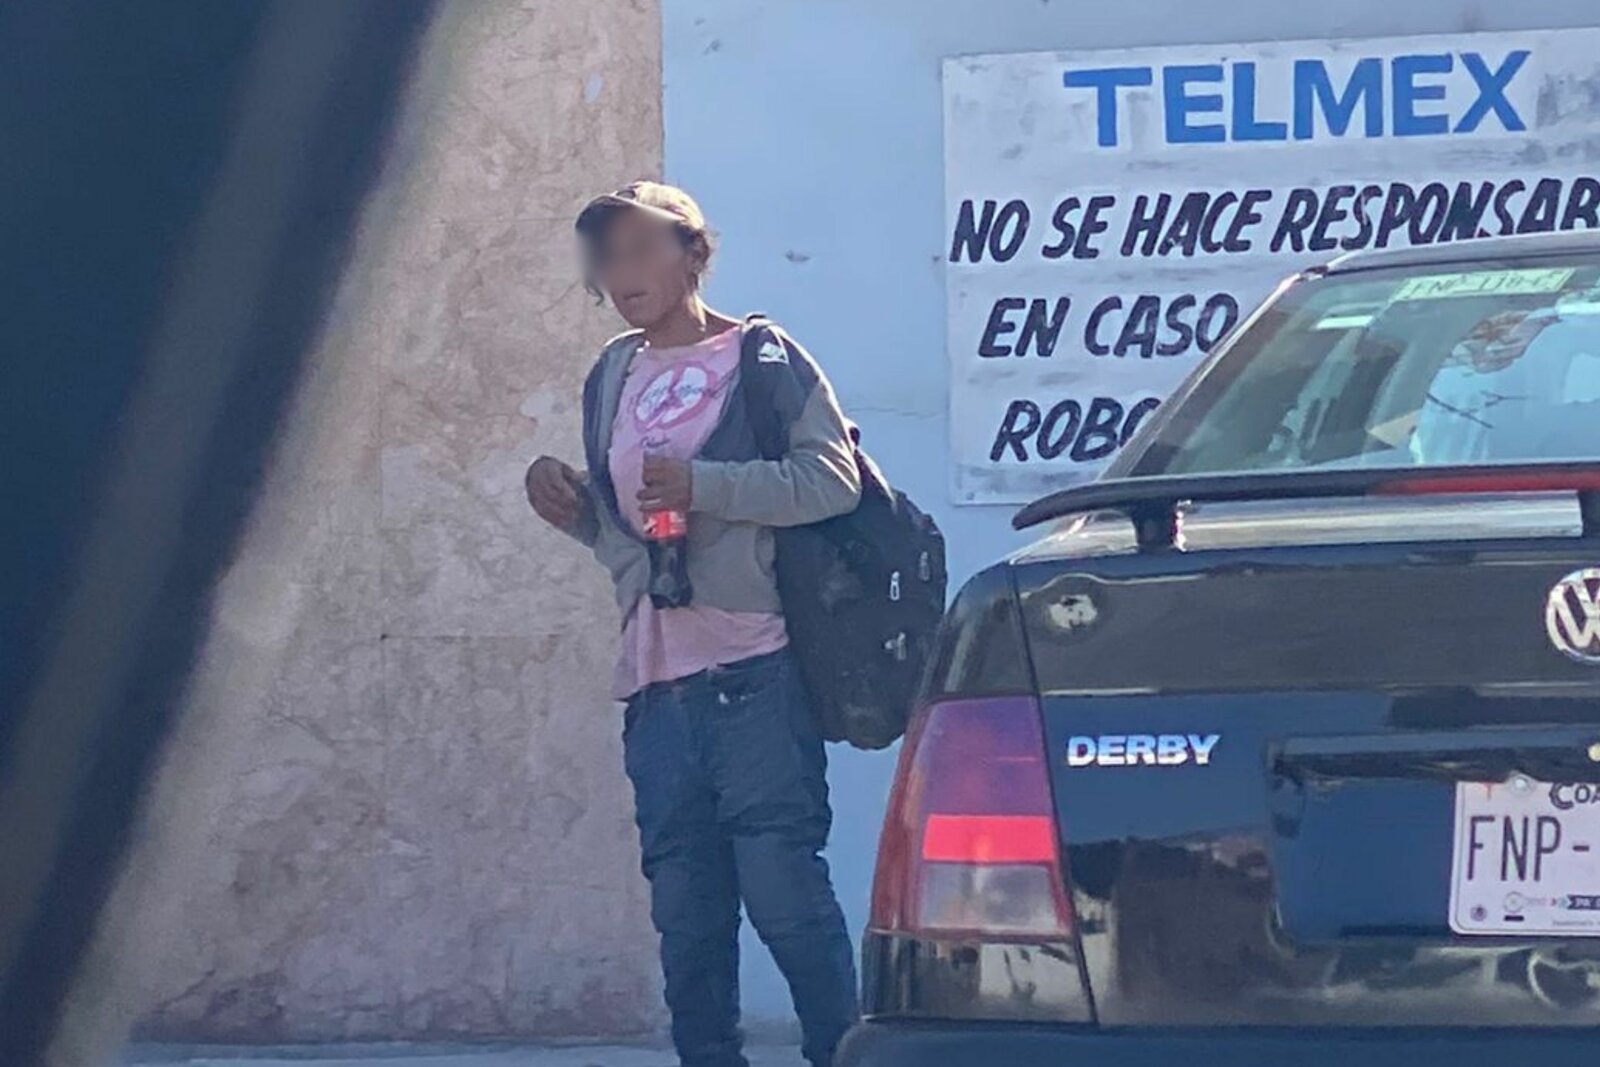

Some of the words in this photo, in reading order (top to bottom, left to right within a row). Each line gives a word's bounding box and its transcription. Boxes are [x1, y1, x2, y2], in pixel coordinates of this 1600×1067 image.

[1063, 50, 1531, 147] TELMEX
[949, 199, 1030, 263] NO
[1042, 196, 1115, 259] SE
[1120, 190, 1272, 257] HACE
[978, 297, 1070, 357] EN
[1084, 293, 1238, 358] CASO
[1067, 733, 1221, 767] DERBY
